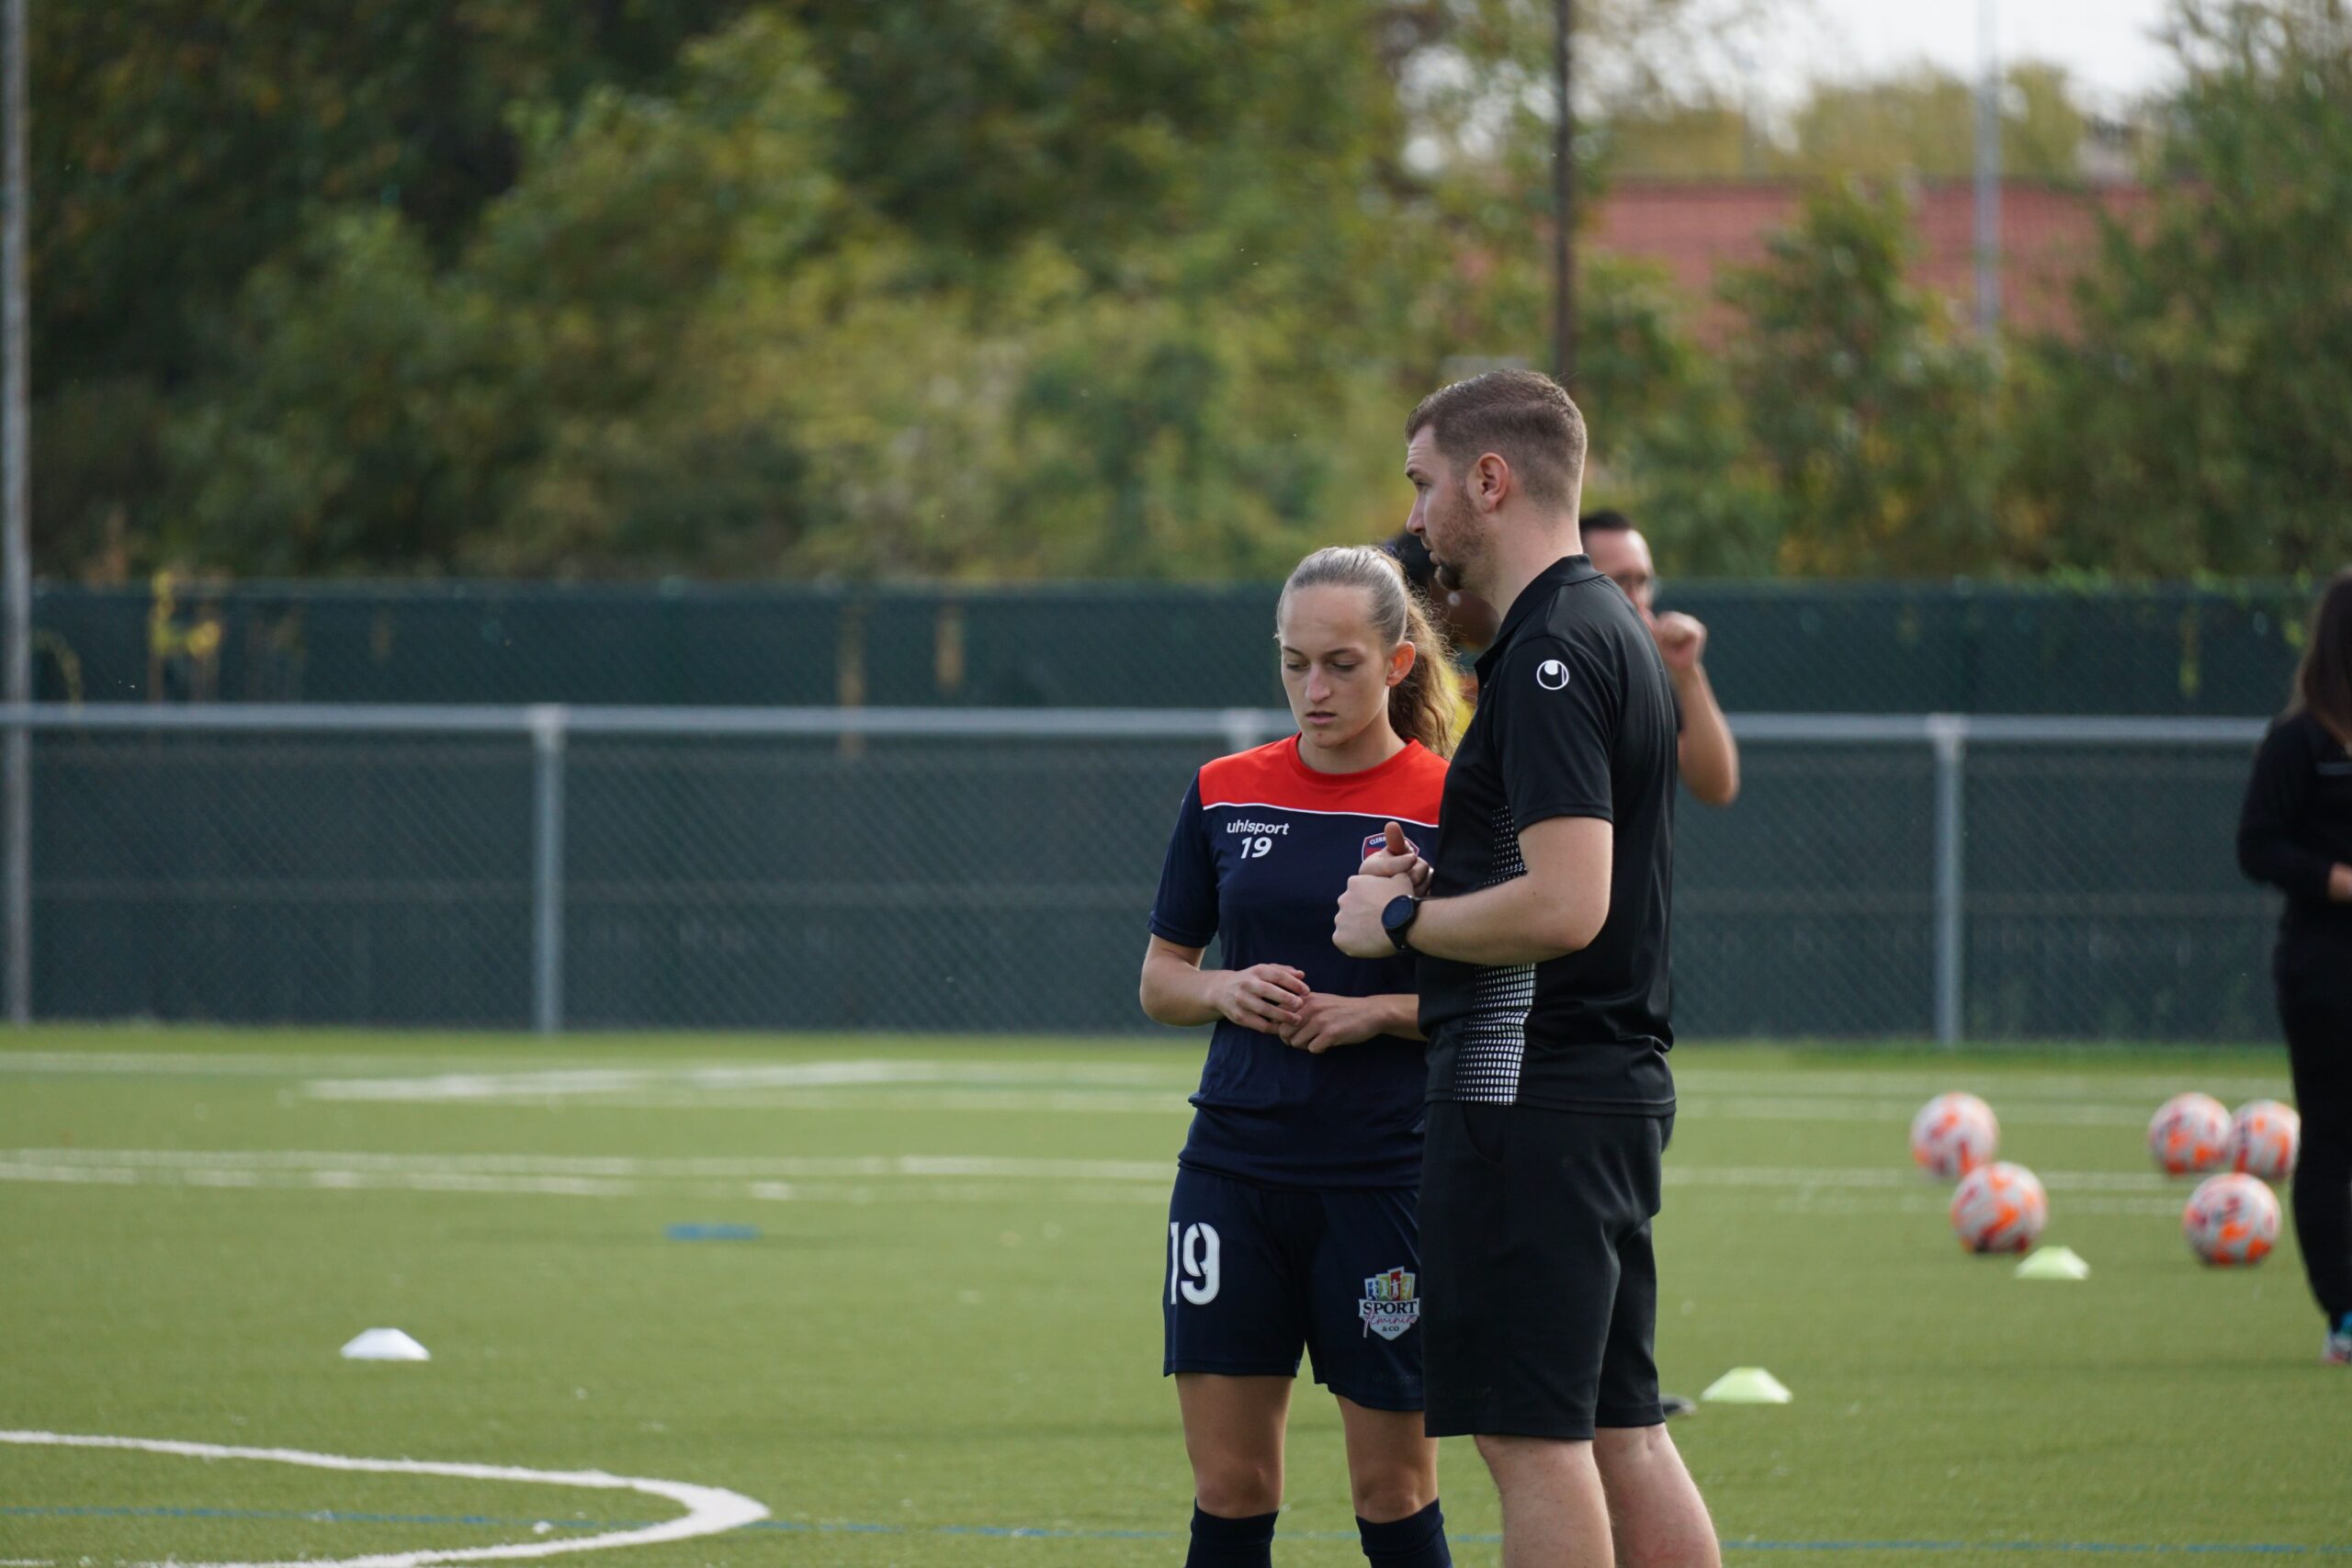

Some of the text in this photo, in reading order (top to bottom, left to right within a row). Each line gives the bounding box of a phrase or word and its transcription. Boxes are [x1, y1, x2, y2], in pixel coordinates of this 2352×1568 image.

[1227, 819, 1289, 835] uhlsport
[1241, 837, 1272, 859] 19
[1170, 1222, 1220, 1304] 19
[1363, 1302, 1417, 1314] SPORT
